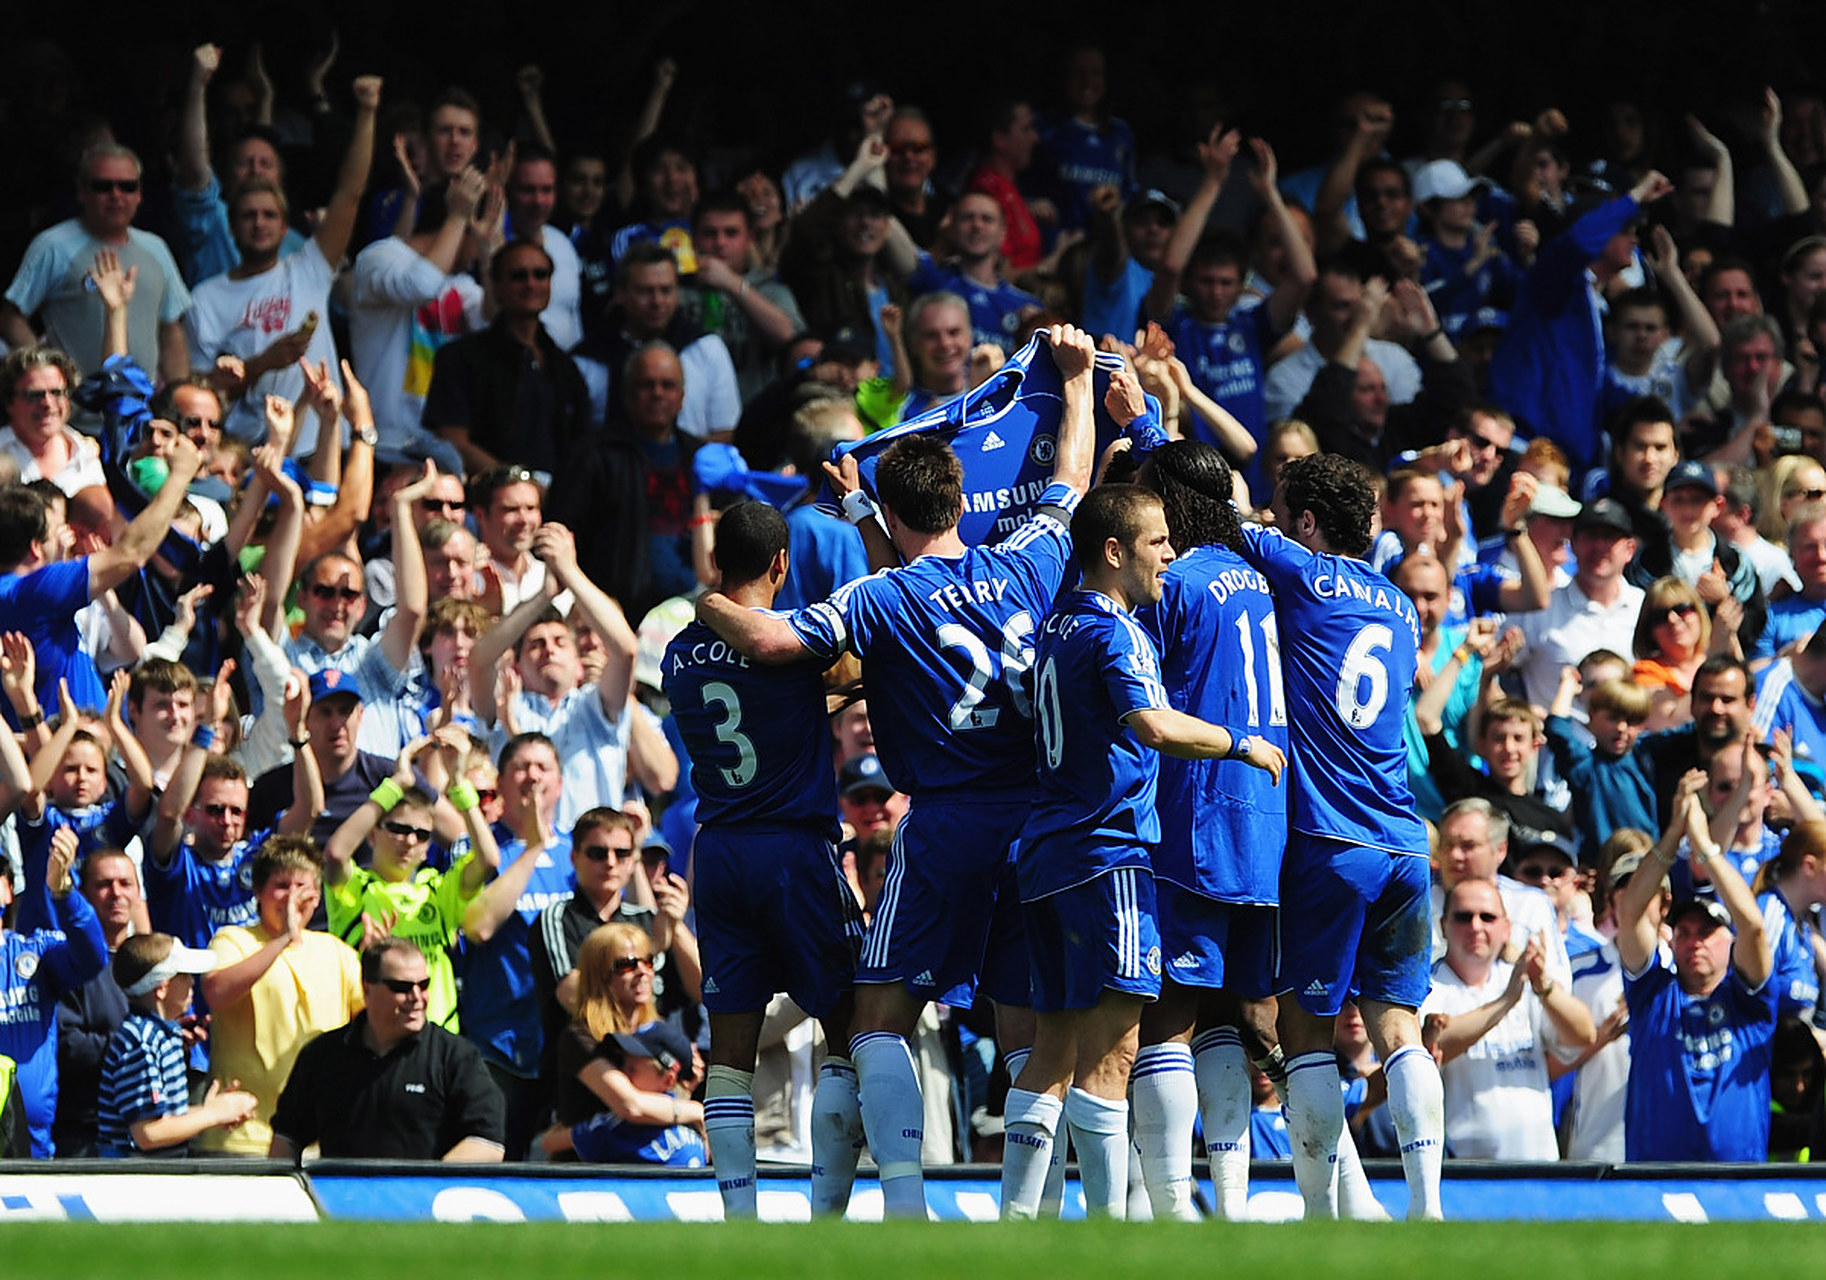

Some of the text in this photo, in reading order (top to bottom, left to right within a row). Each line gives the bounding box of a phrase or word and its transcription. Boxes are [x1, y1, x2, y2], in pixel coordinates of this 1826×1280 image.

[1208, 568, 1275, 606] DROGB
[1235, 609, 1288, 728] 11
[1336, 622, 1394, 730] 6
[702, 682, 757, 787] 3
